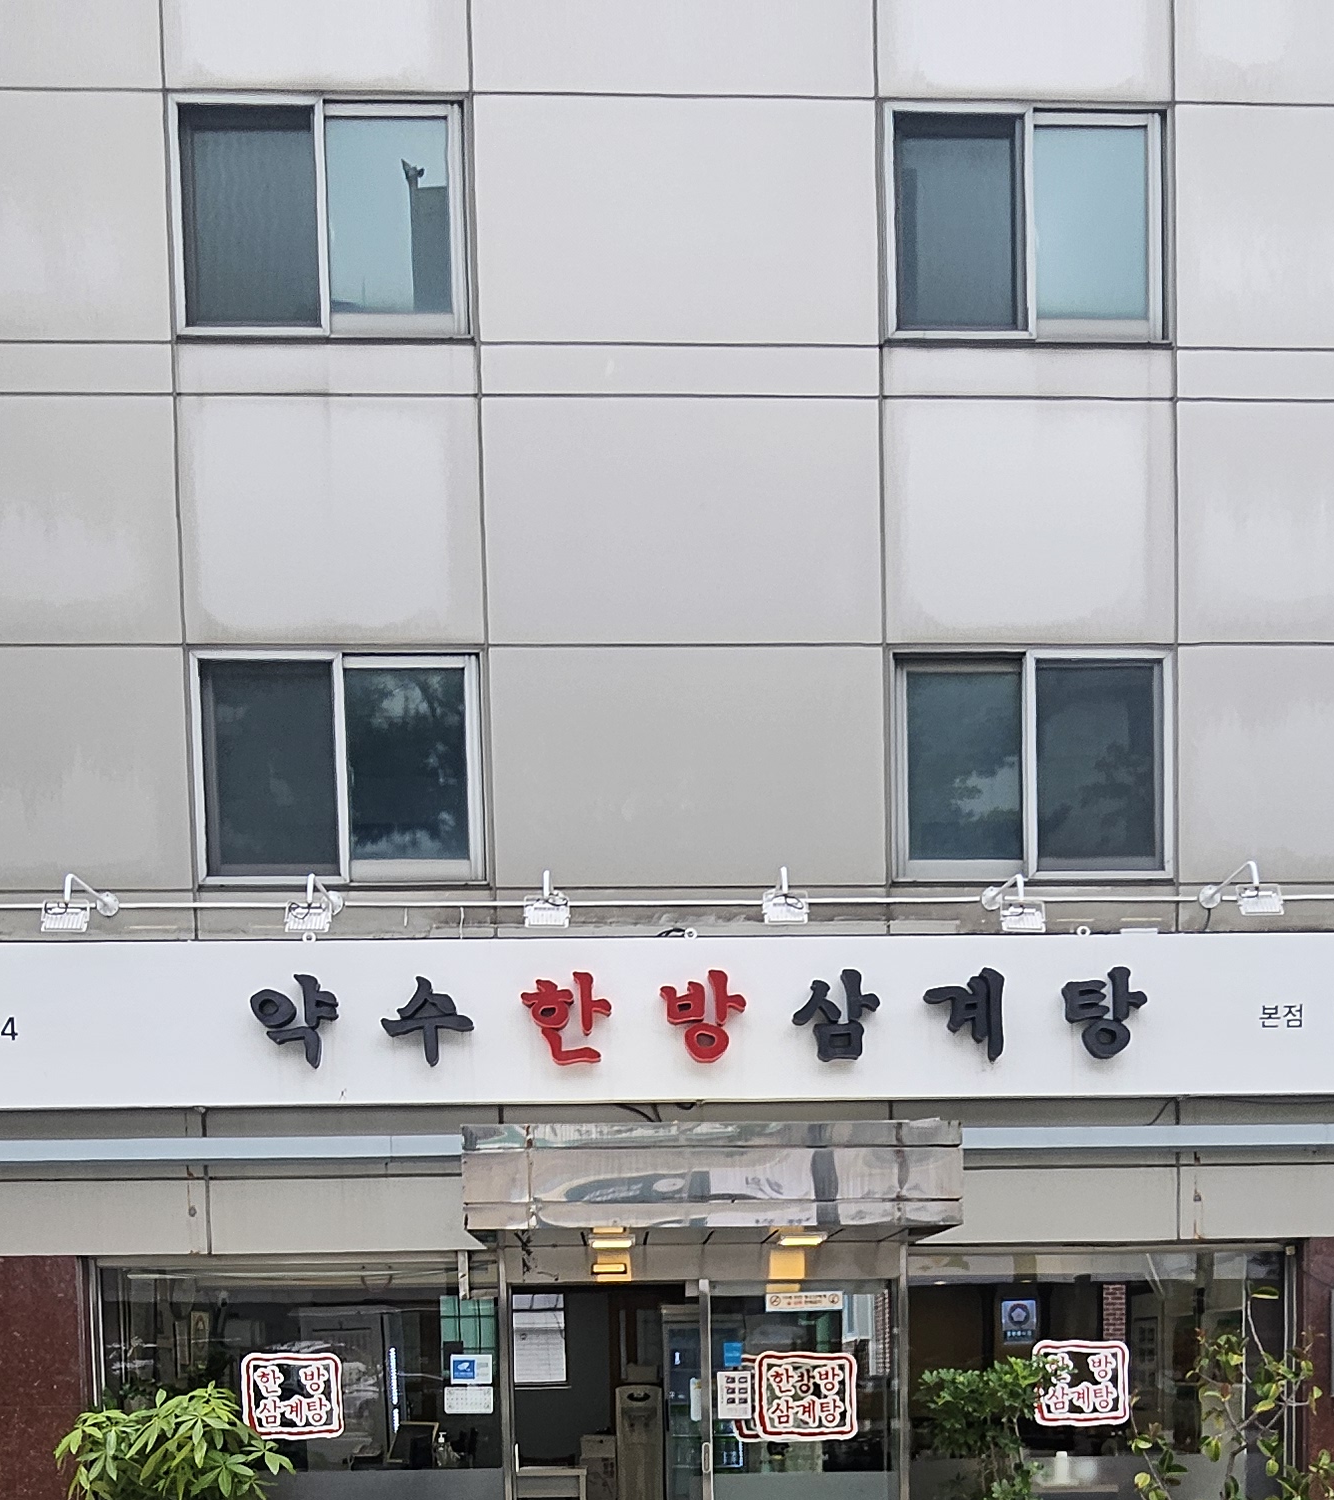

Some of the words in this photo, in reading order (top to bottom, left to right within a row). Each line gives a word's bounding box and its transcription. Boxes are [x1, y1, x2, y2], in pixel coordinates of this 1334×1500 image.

[1258, 1003, 1304, 1028] 본점
[257, 1397, 329, 1425] 삼계탕
[1047, 1385, 1114, 1411] 삼계탕
[770, 1398, 842, 1425] 삼계탕
